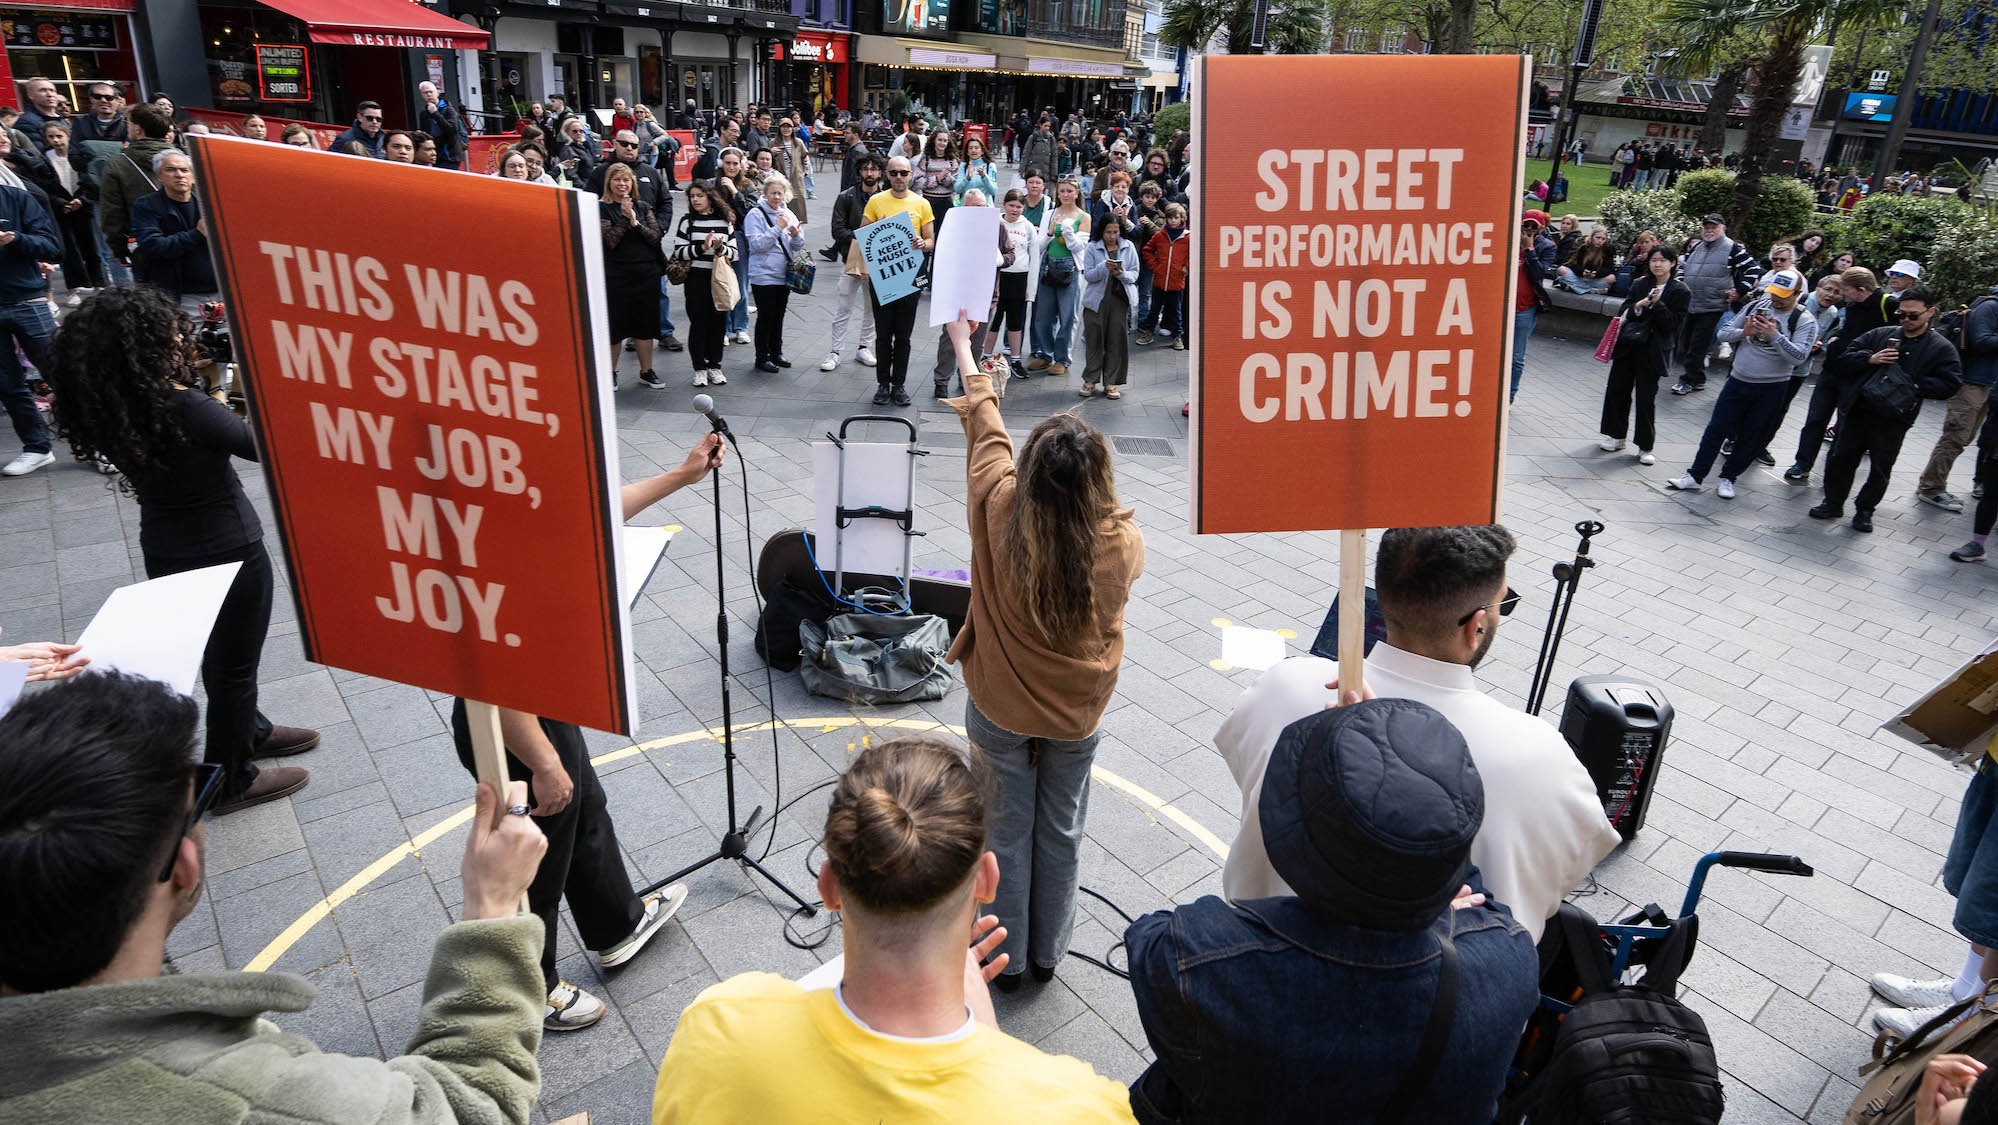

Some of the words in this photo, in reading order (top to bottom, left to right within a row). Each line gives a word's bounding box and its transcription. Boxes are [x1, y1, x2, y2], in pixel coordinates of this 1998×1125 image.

[353, 33, 453, 48] RESTAURANT
[790, 40, 822, 56] Jollibee
[269, 82, 299, 93] SORTED
[1255, 148, 1464, 212] STREET
[877, 240, 904, 256] KEEP
[877, 247, 910, 265] MUSIC
[879, 233, 896, 244] says
[1219, 222, 1494, 268] PERFORMANCE
[258, 240, 394, 322] THIS
[403, 264, 539, 346] WAS
[878, 256, 917, 280] LIVE
[1241, 279, 1293, 340] IS
[1312, 278, 1427, 339] NOT
[1435, 277, 1474, 336] A
[270, 320, 353, 389] MY
[369, 337, 560, 437] STAGE,
[1238, 348, 1474, 423] CRIME!
[310, 402, 394, 470] MY
[414, 423, 542, 509] JOB,
[376, 485, 483, 567] MY
[375, 563, 521, 648] JOY.
